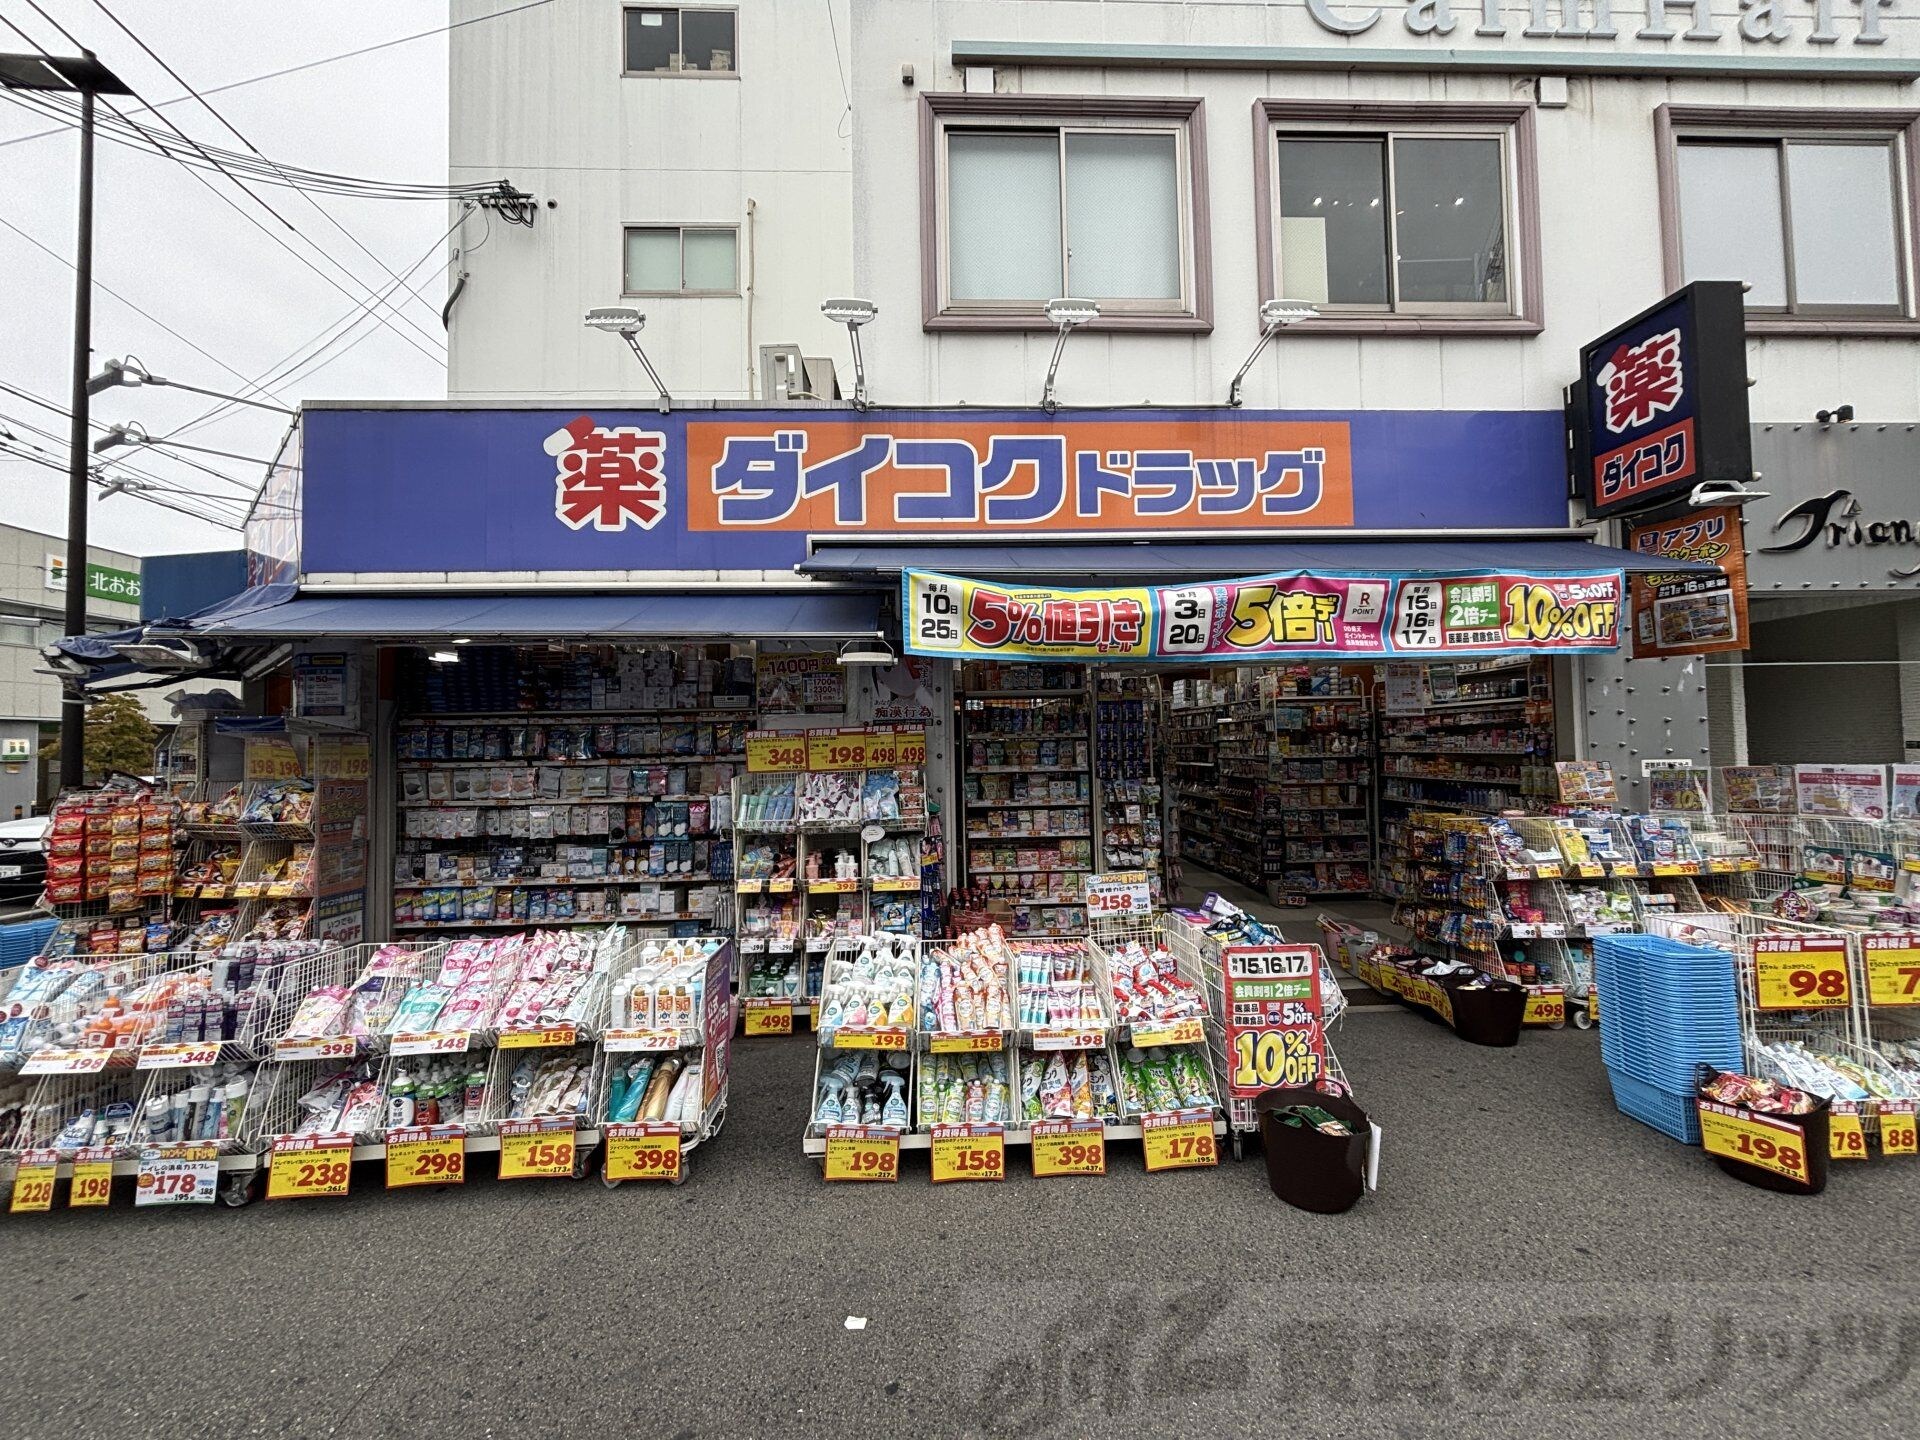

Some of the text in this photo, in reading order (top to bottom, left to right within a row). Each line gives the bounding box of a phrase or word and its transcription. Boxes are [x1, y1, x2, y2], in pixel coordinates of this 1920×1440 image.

[1596, 327, 1684, 434] 薬
[1603, 430, 1686, 498] ダイコク
[544, 419, 669, 532] 薬
[1661, 515, 1725, 549] アプリ
[1760, 489, 1920, 578] Trian
[928, 583, 948, 594] 毎月
[1413, 586, 1430, 594] 毎月
[1449, 585, 1497, 604] 会員割引
[1568, 582, 1614, 600] 5%OFF
[921, 593, 958, 615] 10日
[1173, 599, 1206, 620] 3日
[1406, 595, 1437, 611] 15日
[968, 587, 1144, 650] 5%値引き
[1405, 612, 1435, 629] 16日
[1449, 605, 1498, 627] 2倍デー
[1505, 584, 1616, 641] 10%OFF
[921, 618, 958, 640] 25日
[1169, 624, 1205, 645] 20日
[1401, 630, 1436, 646] 17日
[1096, 642, 1133, 654] セール
[874, 705, 932, 718] 痴漢行為
[768, 748, 804, 766] 348
[828, 746, 865, 764] 198
[871, 747, 895, 763] 498
[901, 746, 925, 762] 498
[1680, 864, 1699, 874] 398
[836, 882, 855, 891] 398
[1100, 893, 1132, 911] 158
[1756, 940, 1801, 952] お買得品
[1865, 937, 1911, 950] お買得品
[1789, 969, 1845, 998] 98
[1282, 1002, 1314, 1026] 5%OFF
[1533, 1003, 1564, 1018] 498
[760, 1014, 791, 1029] 498
[434, 1037, 468, 1050] 148
[542, 1030, 574, 1043] 158
[649, 1035, 677, 1048] 278
[875, 1034, 905, 1046] 198
[971, 1037, 1001, 1049] 158
[1074, 1034, 1103, 1046] 198
[1173, 1029, 1202, 1041] 214
[181, 1050, 216, 1063] 348
[320, 1042, 354, 1056] 398
[69, 1058, 104, 1070] 198
[1234, 1029, 1320, 1088] 10%OFF
[1699, 1101, 1750, 1120] お買得品
[502, 1123, 538, 1134] お買得品
[1033, 1124, 1068, 1135] お買得品
[1144, 1116, 1178, 1128] お買得品
[388, 1132, 428, 1144] お買得品
[609, 1127, 645, 1137] お買得品
[828, 1129, 865, 1139] お買得品
[932, 1128, 969, 1138] お買得品
[1833, 1131, 1863, 1150] 78
[1888, 1129, 1915, 1148] 88
[274, 1139, 315, 1151] お買得品
[1169, 1135, 1213, 1159] 178
[1737, 1133, 1802, 1170] 198
[414, 1152, 462, 1176] 298
[525, 1143, 572, 1168] 158
[632, 1149, 678, 1170] 398
[849, 1151, 896, 1172] 198
[956, 1149, 1001, 1171] 158
[1057, 1144, 1102, 1166] 398
[296, 1162, 348, 1187] 238
[20, 1182, 52, 1203] 228
[79, 1178, 109, 1199] 198
[154, 1173, 197, 1195] 178
